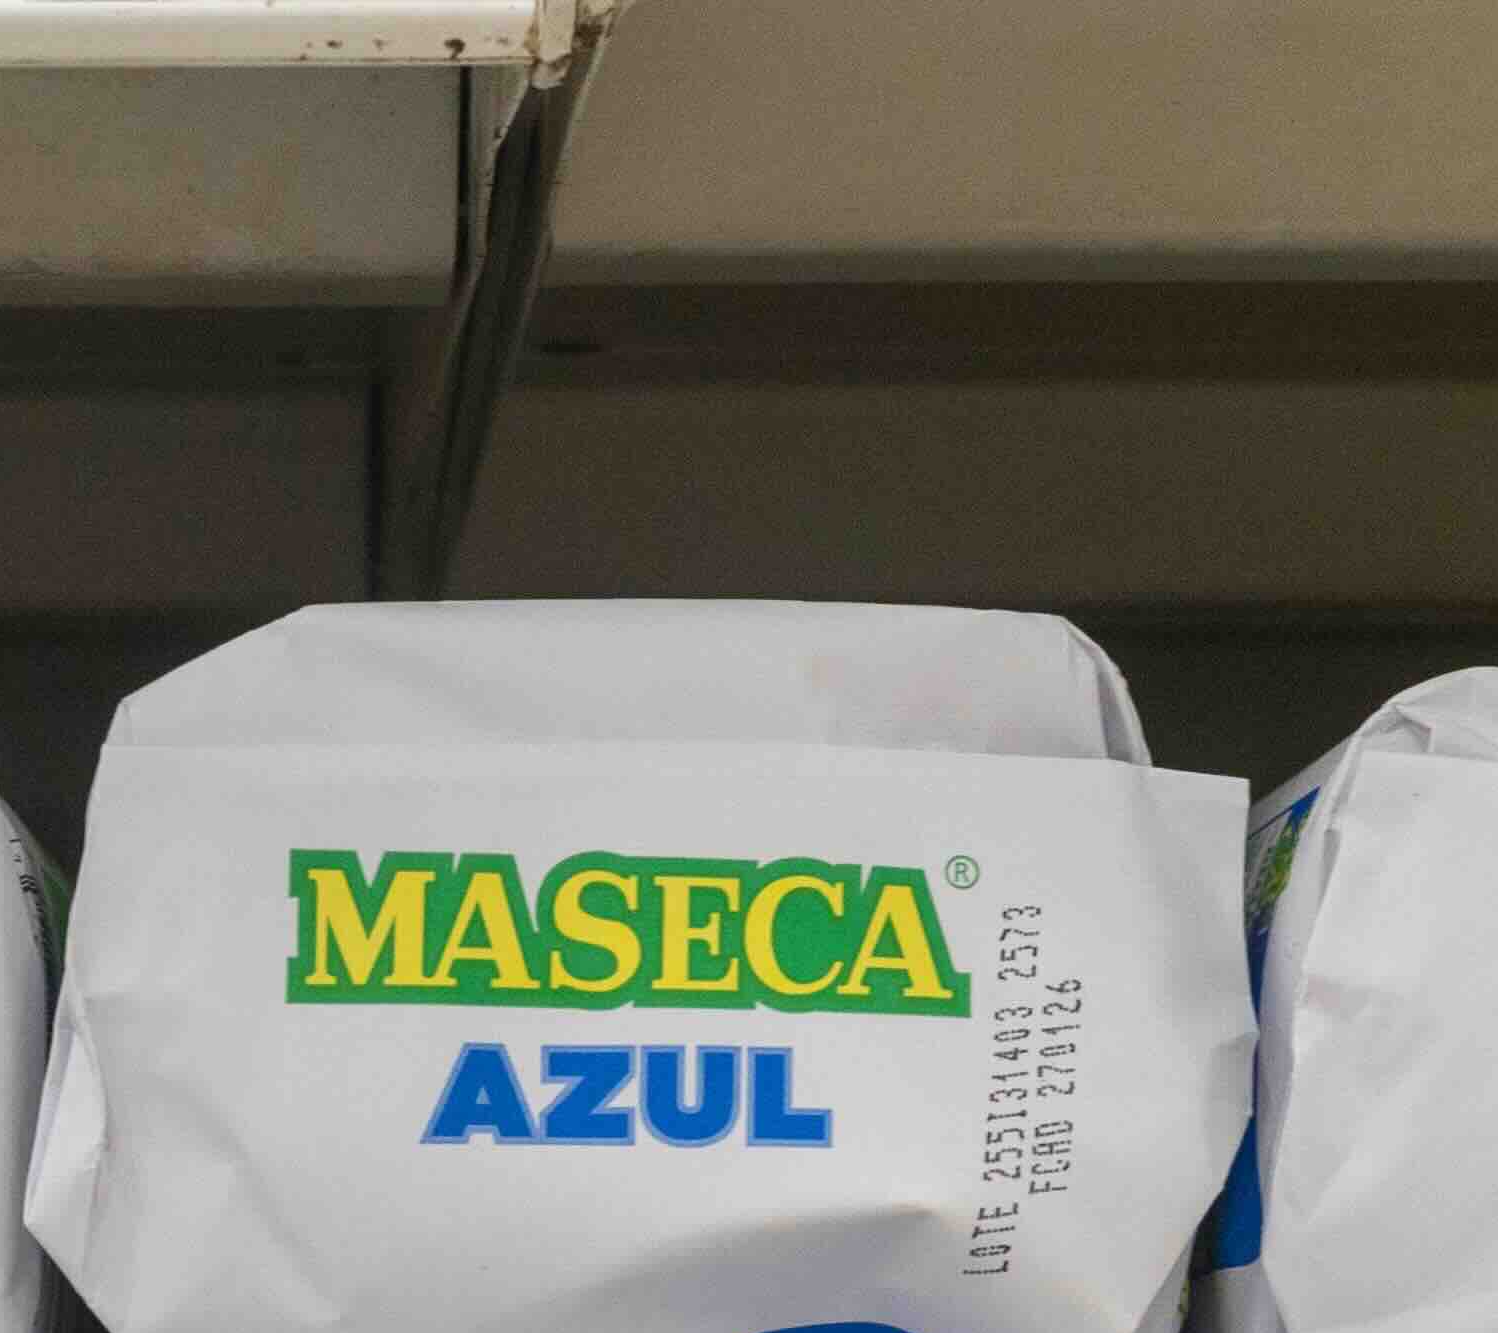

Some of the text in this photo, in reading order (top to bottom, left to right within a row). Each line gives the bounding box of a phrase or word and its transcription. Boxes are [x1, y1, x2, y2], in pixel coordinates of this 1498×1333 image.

[304, 867, 953, 1002] MASECA
[421, 1041, 834, 1148] AZUL
[963, 1202, 1019, 1274] LOTE
[997, 905, 1041, 980] 2573
[1029, 979, 1081, 1193] FCAD 270126
